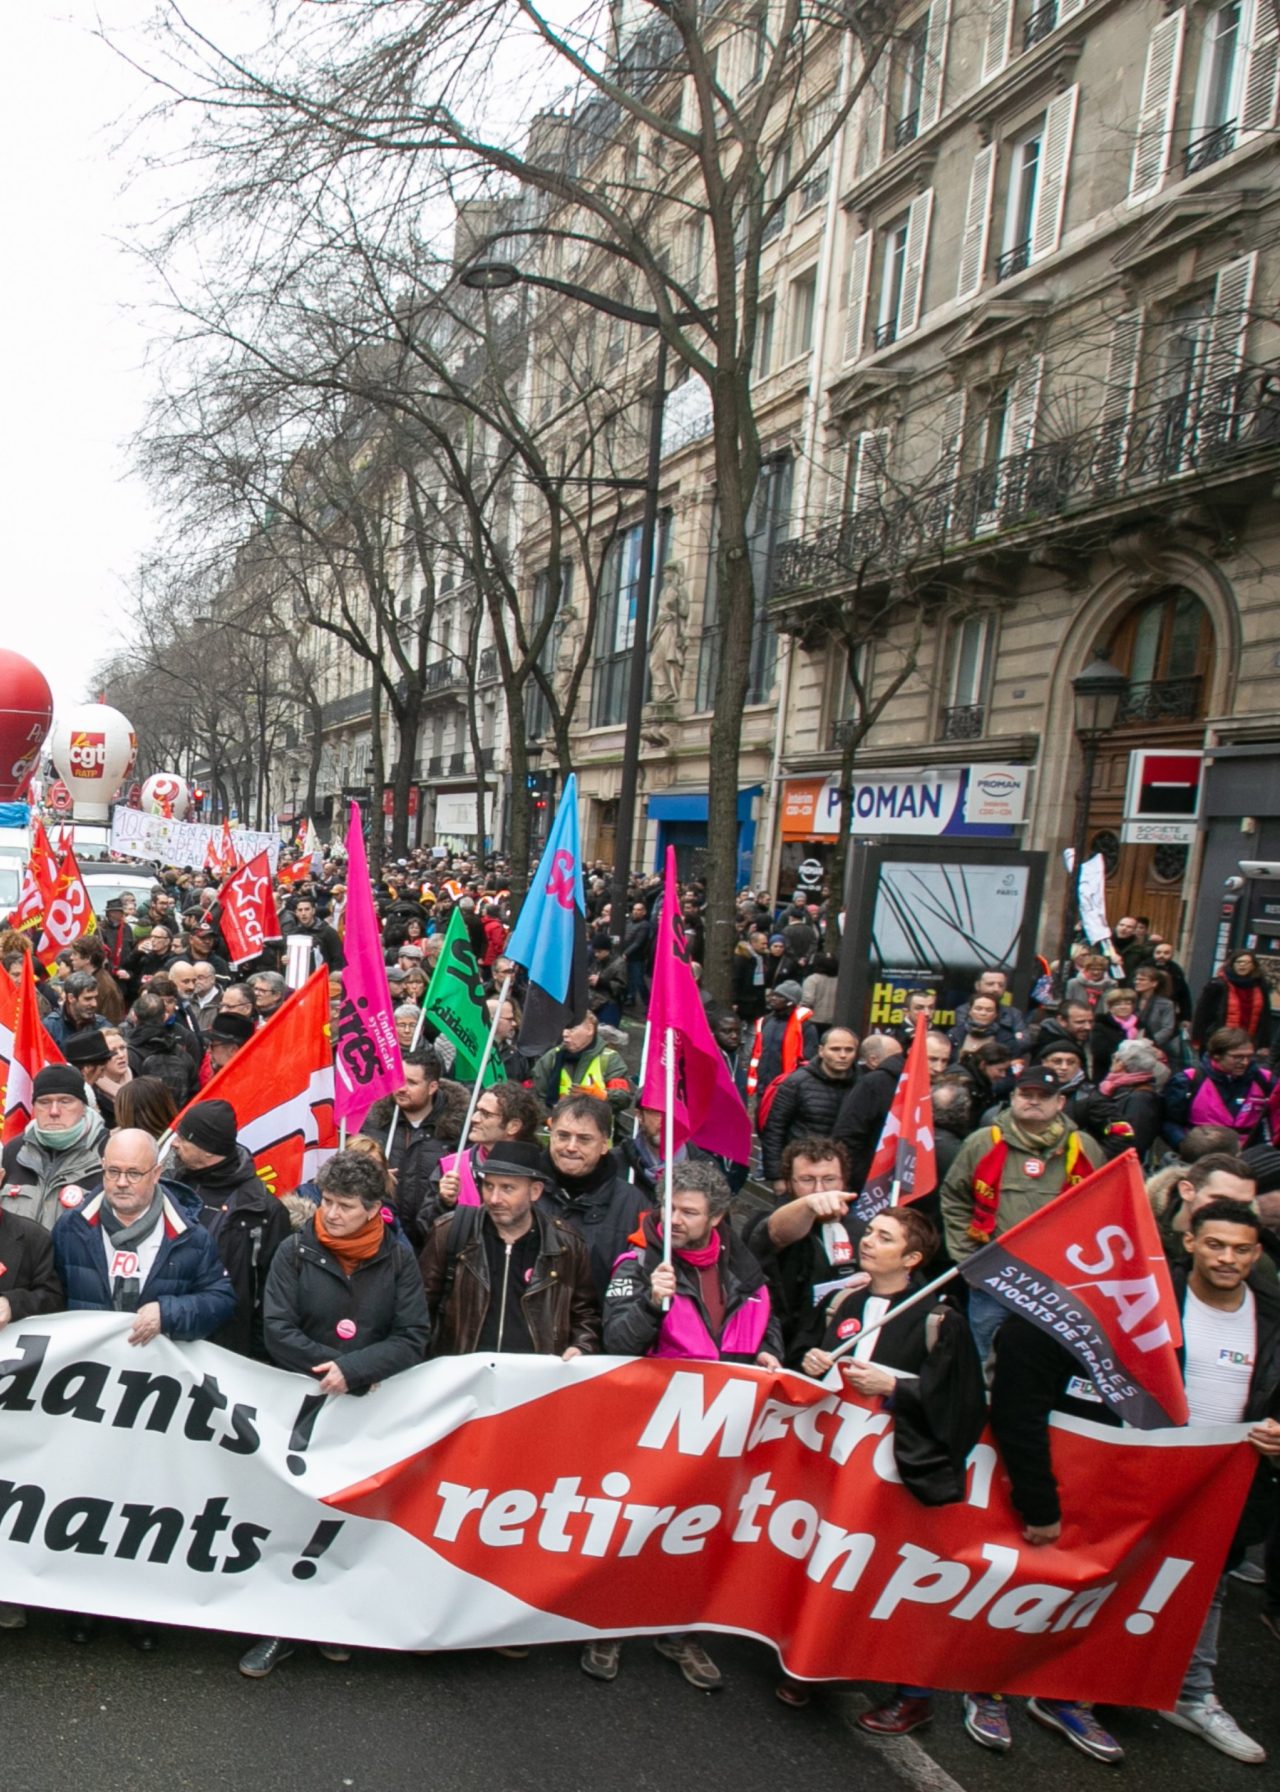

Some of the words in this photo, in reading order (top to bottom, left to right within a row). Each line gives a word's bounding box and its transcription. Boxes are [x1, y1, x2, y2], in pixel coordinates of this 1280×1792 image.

[70, 743, 107, 769] cgt
[977, 779, 1022, 791] PROMAN
[996, 889, 1019, 897] PARIS
[239, 907, 265, 946] PCF
[368, 1015, 395, 1071] syndicale
[376, 1010, 397, 1049] Union
[111, 1252, 138, 1276] FO
[984, 1275, 1058, 1325] AVOCATS
[1052, 1317, 1081, 1343] DE
[1074, 1337, 1126, 1405] FRANCE
[1000, 1264, 1104, 1347] SYNDICAT
[1101, 1358, 1138, 1398] DES
[286, 1393, 330, 1477] !
[292, 1518, 346, 1581] !
[433, 1471, 722, 1559] retire
[731, 1471, 876, 1592] ton
[870, 1542, 1117, 1637] plan
[1125, 1557, 1195, 1637] !
